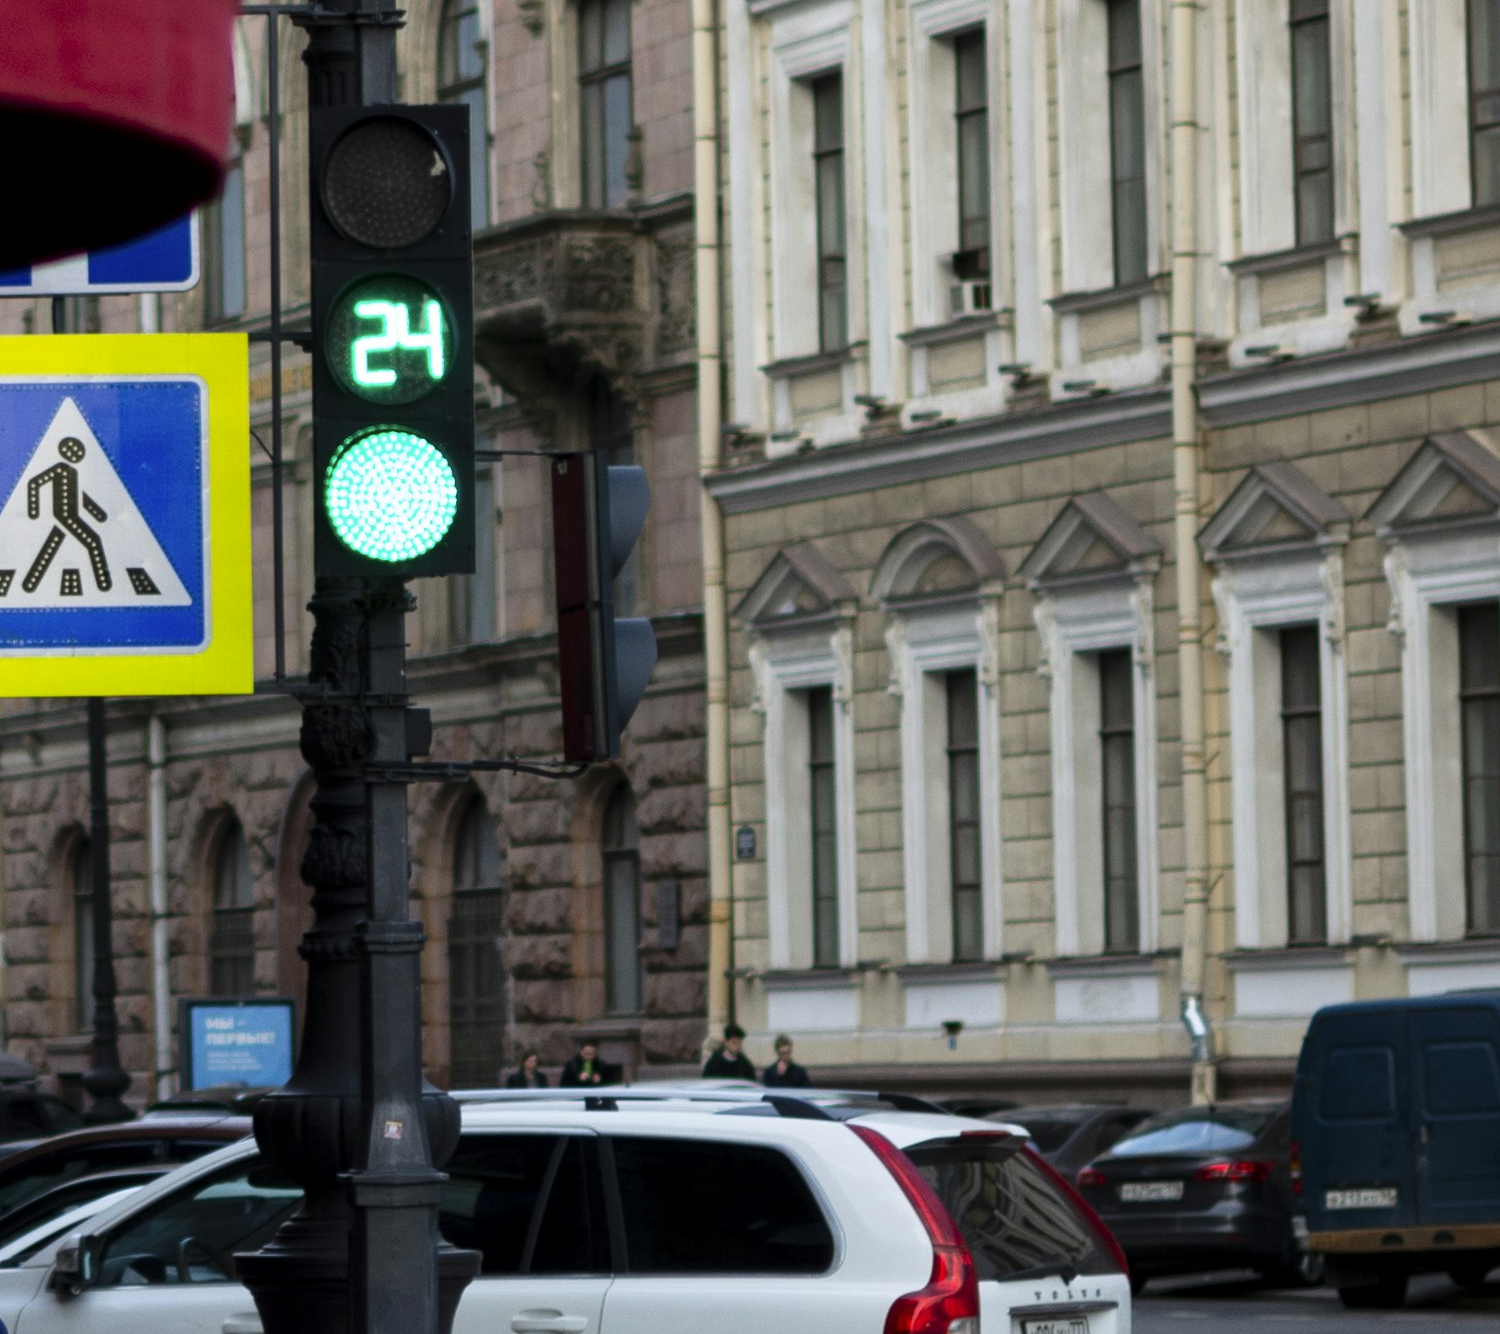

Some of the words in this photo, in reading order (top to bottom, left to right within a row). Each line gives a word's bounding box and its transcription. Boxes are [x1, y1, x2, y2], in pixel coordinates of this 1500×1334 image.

[352, 300, 444, 387] 24
[205, 1017, 234, 1030] МЫ
[205, 1031, 276, 1045] ПЕРВЫЕ!
[1034, 1289, 1102, 1301] VOLVO
